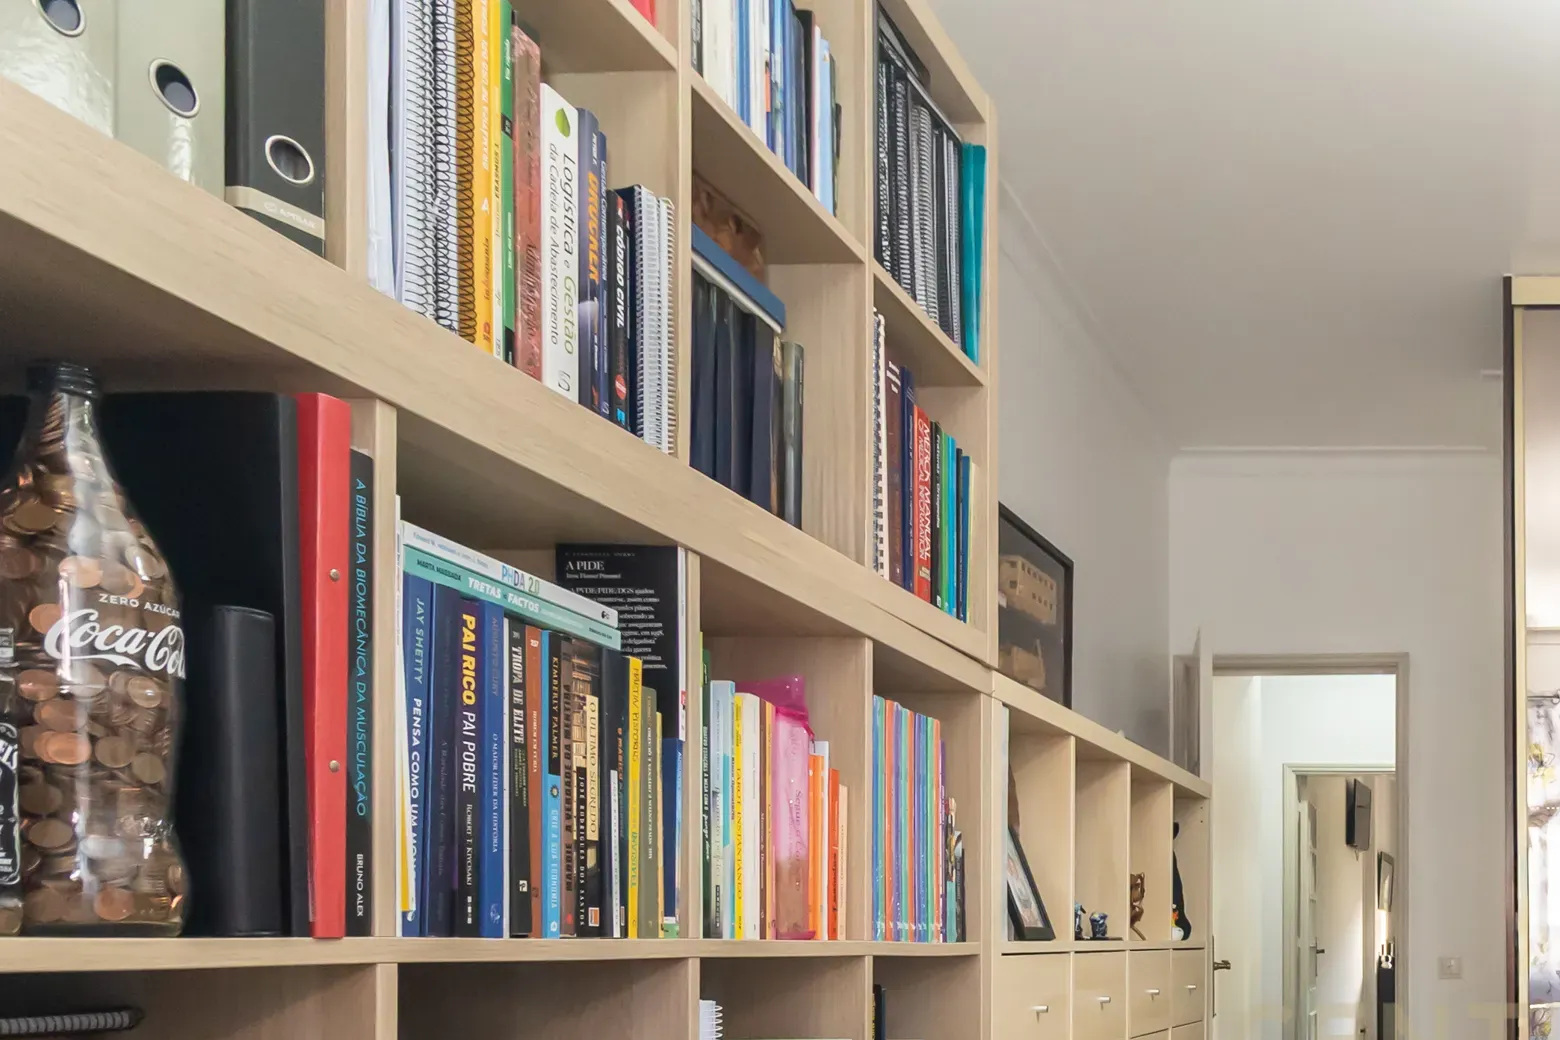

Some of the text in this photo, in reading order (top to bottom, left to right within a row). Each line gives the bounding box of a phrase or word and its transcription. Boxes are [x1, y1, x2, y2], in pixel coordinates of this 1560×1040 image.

[549, 142, 560, 345] da Cadeia de Abastecimento
[587, 171, 599, 286] DRUCKER
[560, 153, 577, 355] Logística e Gestão
[615, 224, 627, 328] CÓDIGO CIVIL
[923, 422, 931, 560] MERCK MANUAL
[501, 564, 526, 589] PHDA
[566, 561, 605, 571] A PIDE
[98, 593, 182, 619] ZERO AZÚCAR
[468, 577, 502, 599] TRETAS
[507, 593, 540, 612] FACTOS
[354, 479, 369, 817] A BÍBLIA DA BIOMECÂNICA DA MUSCULAÇÃO
[414, 598, 425, 685] JAY SHETTY
[511, 646, 524, 684] TROPA
[461, 613, 476, 793] PAI RICO PAI POBRE
[512, 688, 524, 705] DE
[590, 702, 597, 713] O
[492, 733, 499, 741] O
[512, 709, 525, 745] ELITE
[551, 716, 559, 759] PALMER
[411, 698, 422, 827] PENSA COMO UM
[492, 773, 500, 798] LÍDER
[492, 800, 499, 811] DA
[356, 853, 364, 918] BRUNO ALEX
